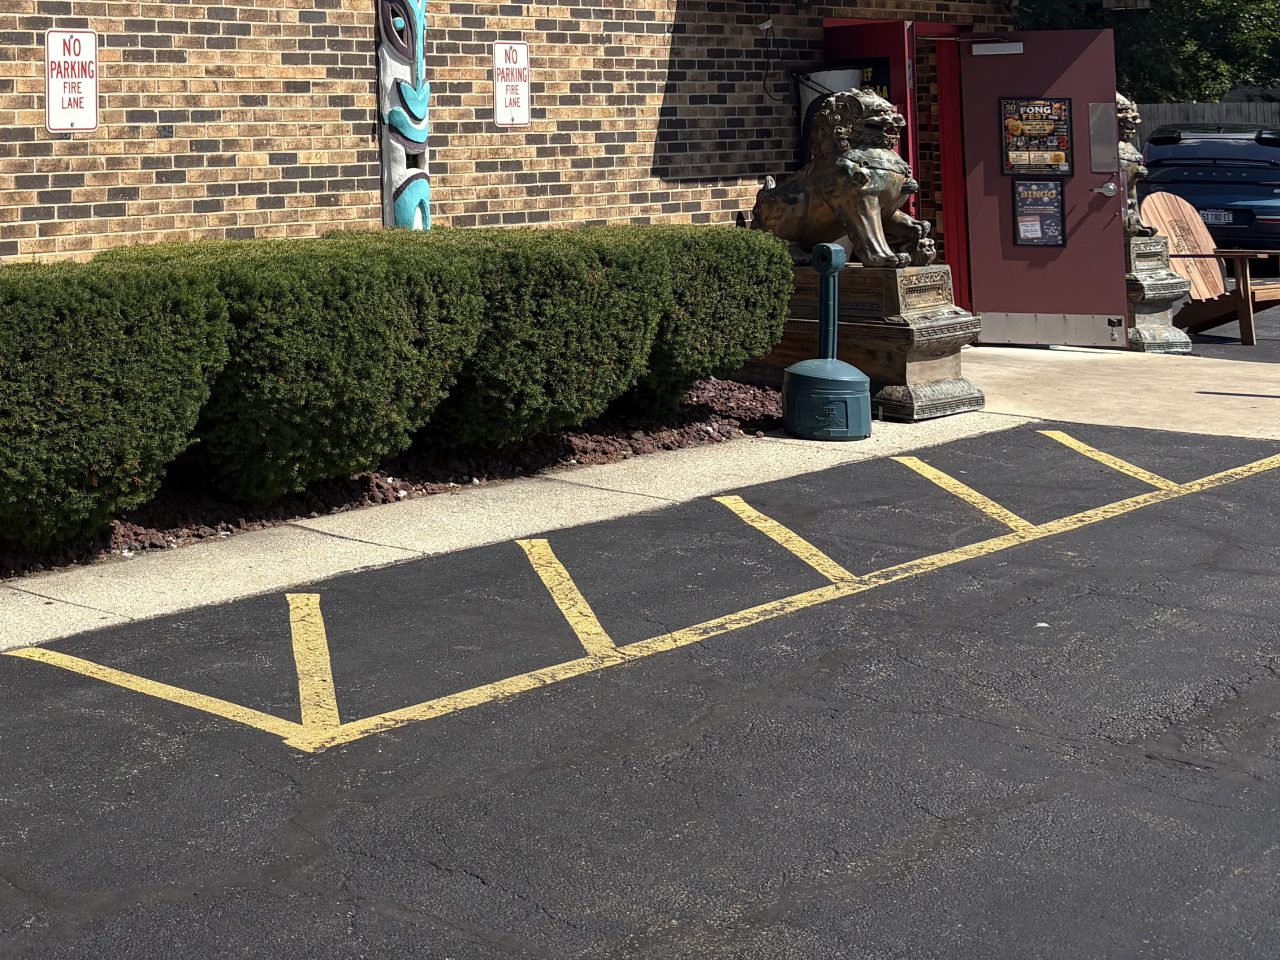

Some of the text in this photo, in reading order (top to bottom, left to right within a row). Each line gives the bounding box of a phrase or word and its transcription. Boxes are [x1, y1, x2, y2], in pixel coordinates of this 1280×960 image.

[63, 38, 81, 56] NO
[504, 49, 518, 64] NO
[50, 60, 94, 79] PARKING
[496, 67, 527, 82] PARKING
[63, 81, 82, 94] FIRE
[505, 84, 519, 96] FIRE
[61, 96, 84, 110] LANE
[504, 97, 520, 108] LANE
[1019, 106, 1052, 114] FONG
[1020, 190, 1057, 199] BINGO
